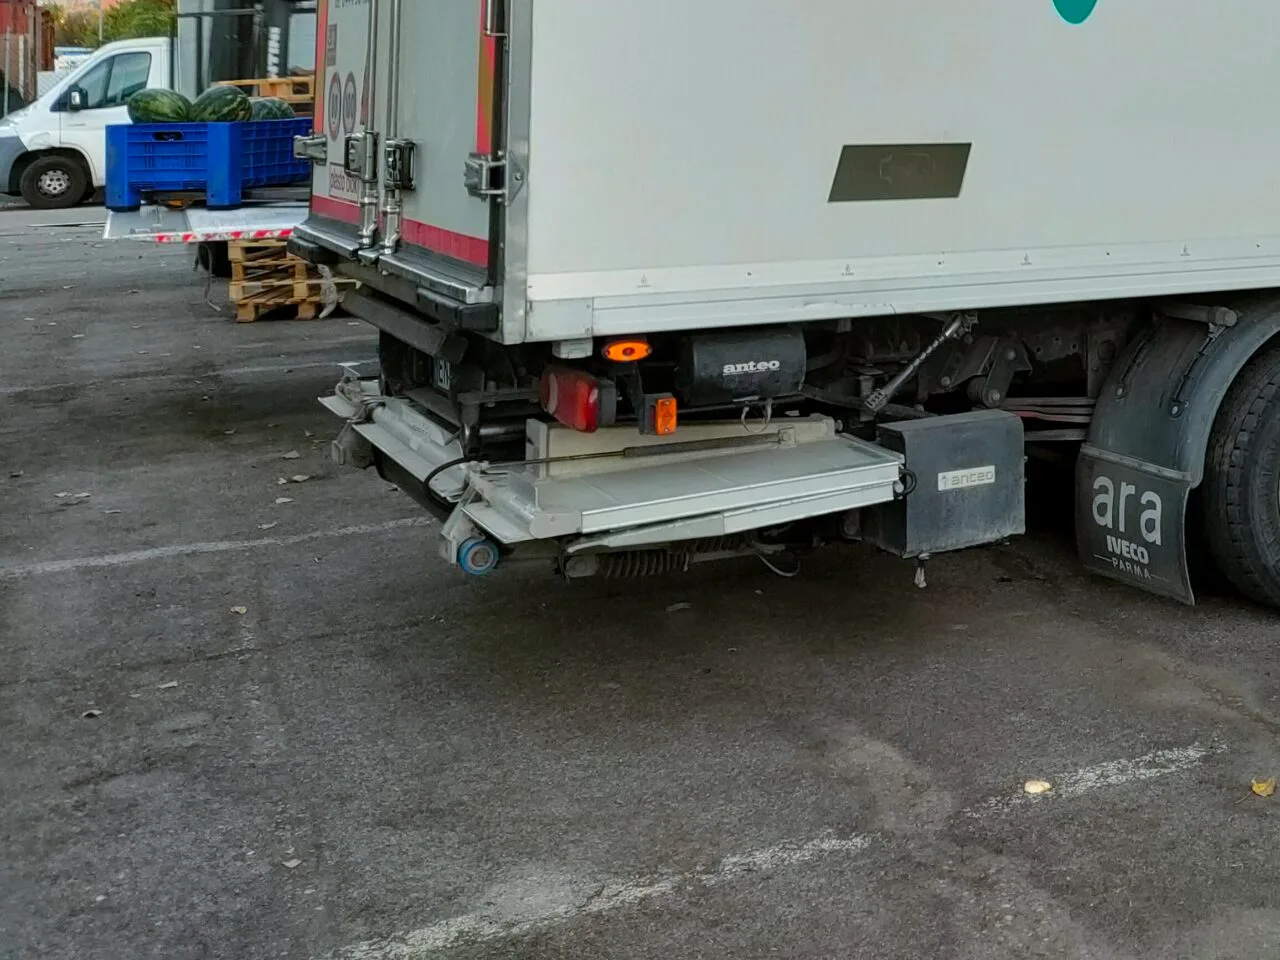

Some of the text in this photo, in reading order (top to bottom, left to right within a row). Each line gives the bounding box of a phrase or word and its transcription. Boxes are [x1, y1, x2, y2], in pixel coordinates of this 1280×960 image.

[723, 360, 780, 373] anteo
[951, 470, 994, 486] anteo
[1092, 475, 1162, 546] ara
[1106, 534, 1149, 565] IVECO
[1111, 556, 1152, 581] PARMA
